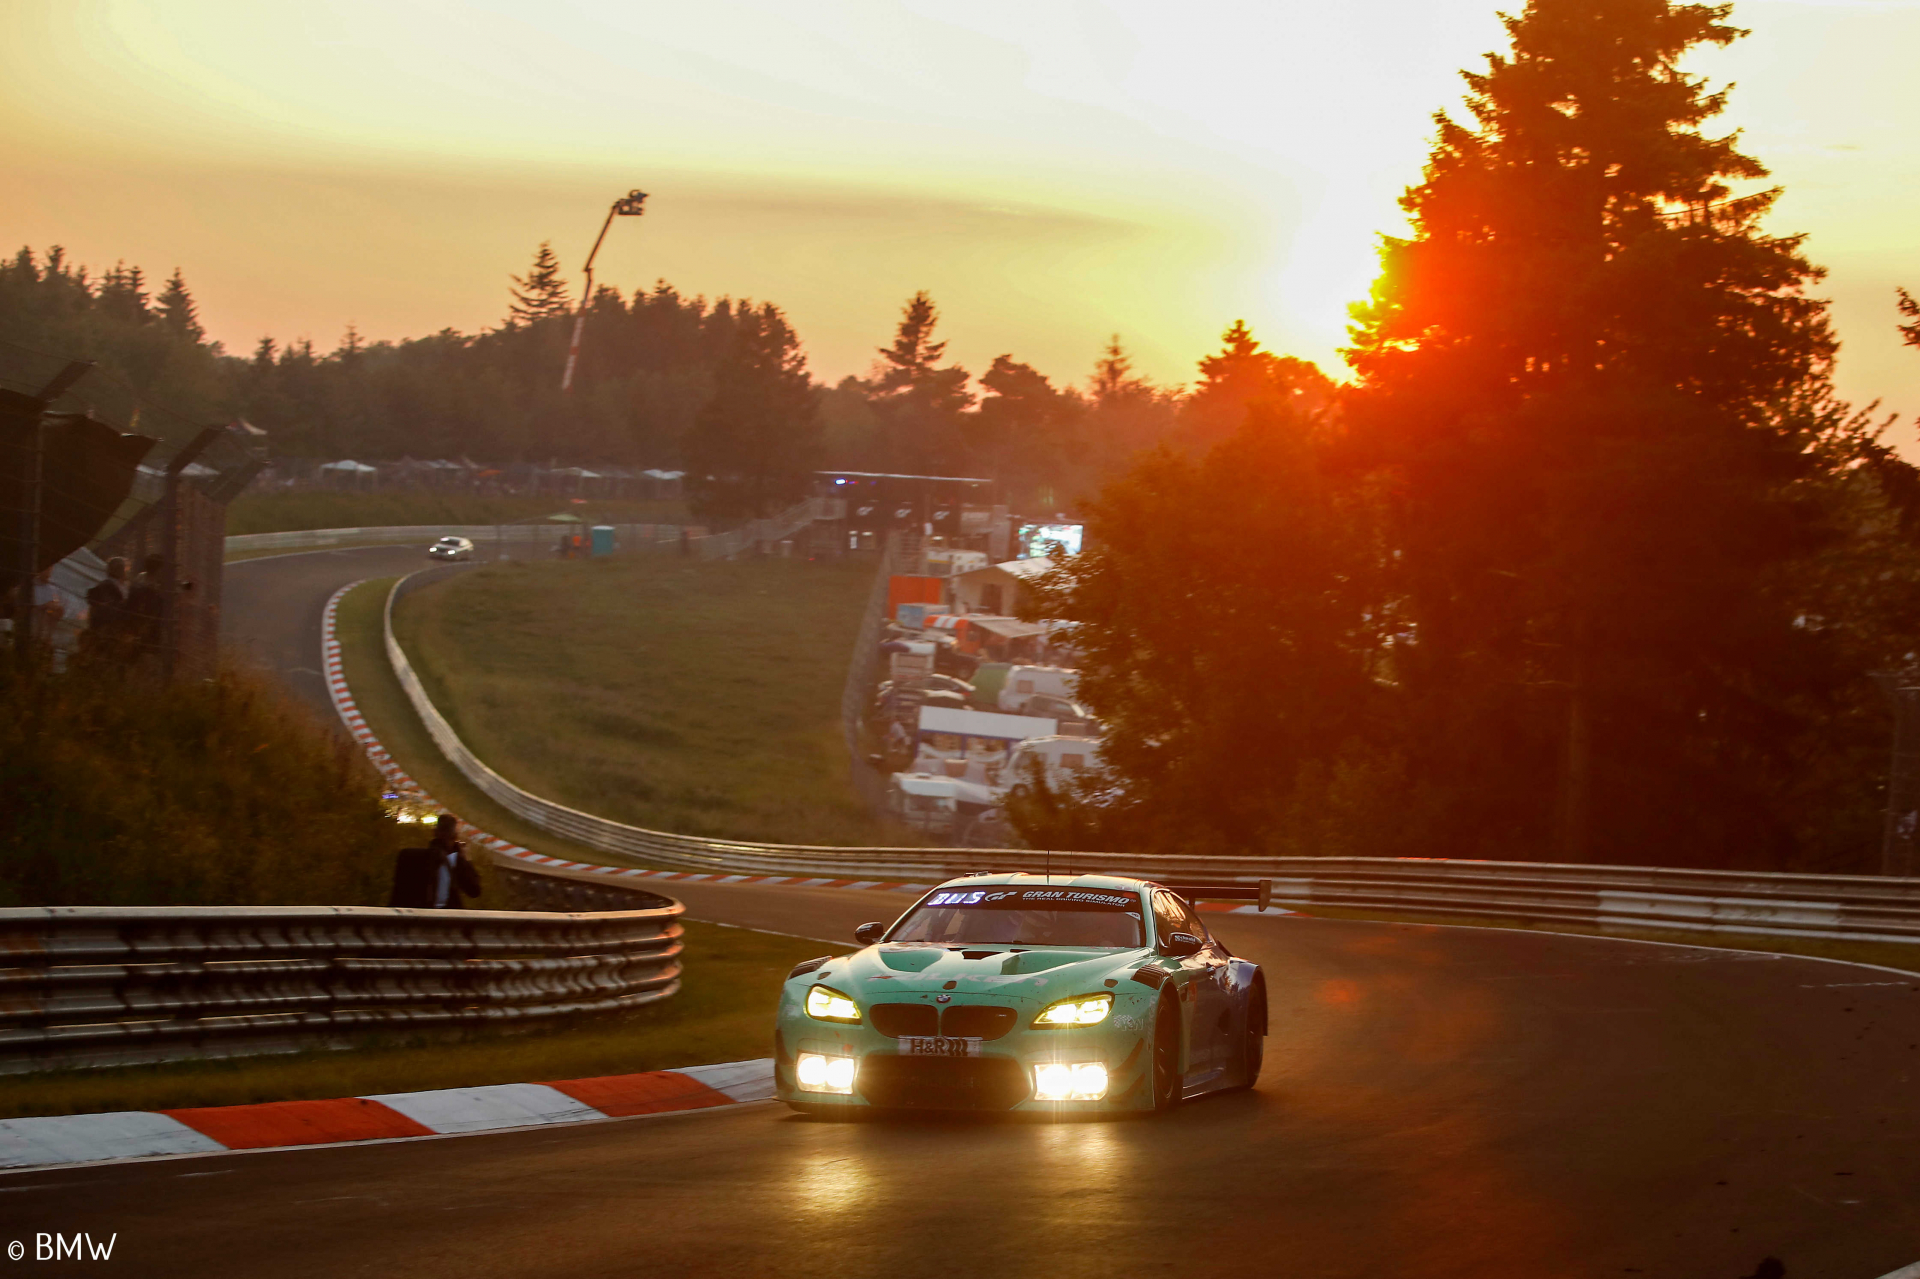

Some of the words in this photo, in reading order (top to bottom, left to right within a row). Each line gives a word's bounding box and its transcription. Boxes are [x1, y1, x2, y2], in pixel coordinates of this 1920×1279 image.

[1022, 890, 1064, 898] GRAN
[1065, 891, 1130, 904] TURISMO
[910, 1038, 946, 1054] H&R
